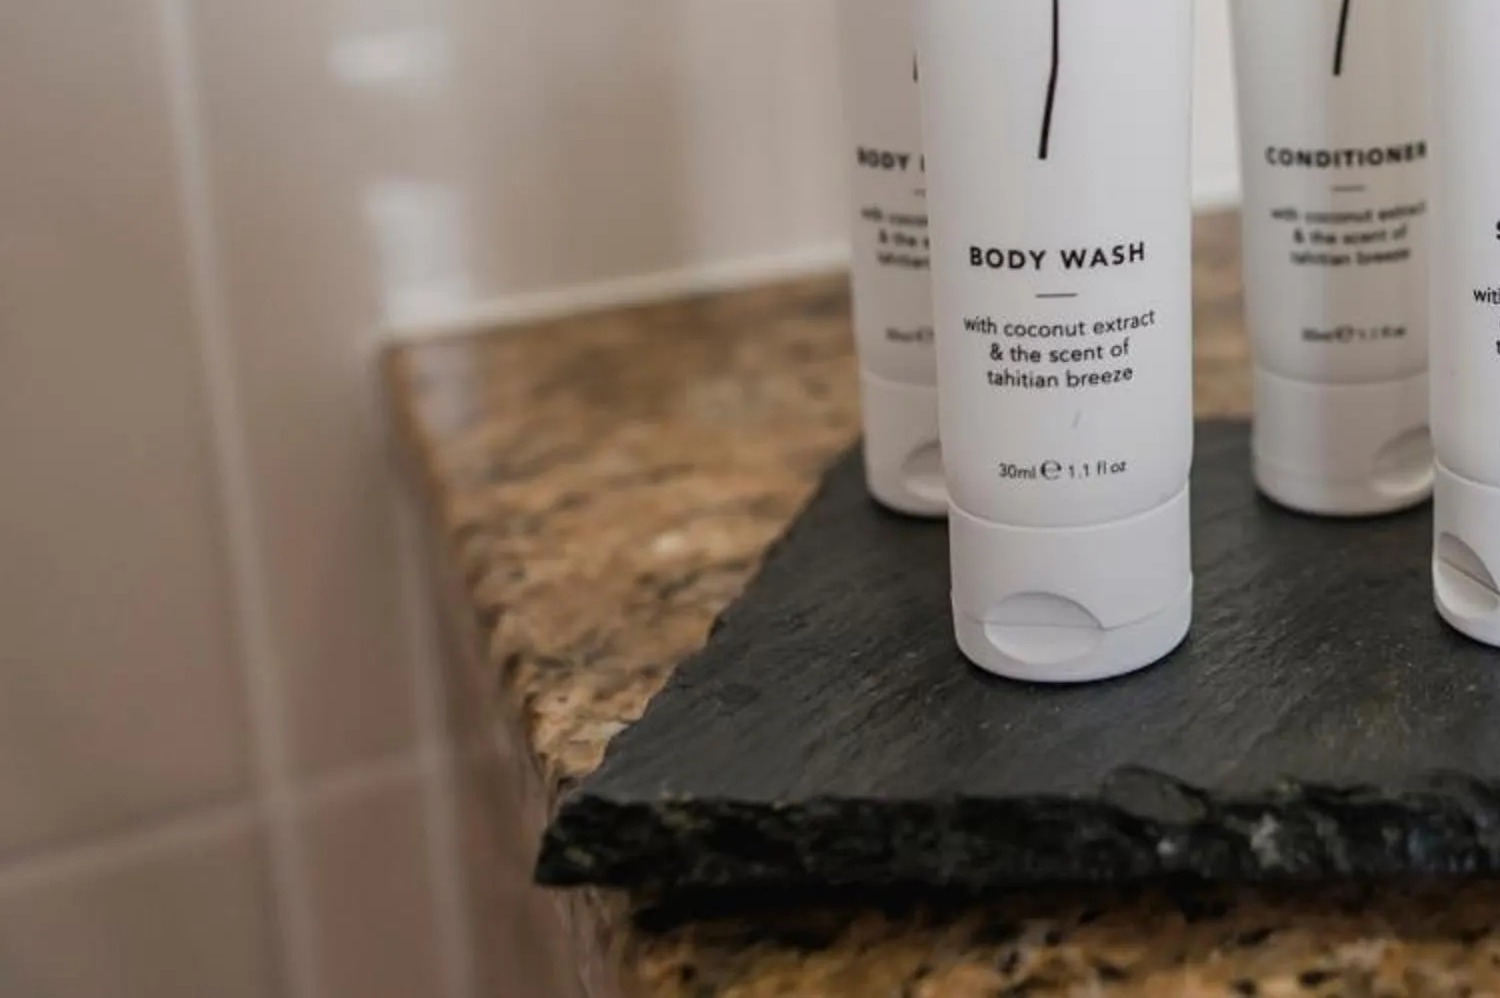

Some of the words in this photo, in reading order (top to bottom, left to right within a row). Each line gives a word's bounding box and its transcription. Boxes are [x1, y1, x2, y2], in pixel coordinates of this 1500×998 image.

[969, 245, 1047, 271] BODY
[1059, 241, 1145, 270] WASH
[963, 315, 998, 335] with
[1003, 320, 1086, 339] coconut
[1092, 309, 1155, 336] extract
[989, 341, 1004, 362] &
[1008, 343, 1042, 364] the
[1048, 345, 1104, 364] scent
[1109, 336, 1130, 358] of
[986, 367, 1060, 389] tahitian
[1065, 366, 1134, 389] breeze
[998, 461, 1038, 481] 30ml
[1067, 463, 1090, 479] 1.1
[1096, 459, 1108, 476] fl
[1109, 460, 1127, 475] oz
